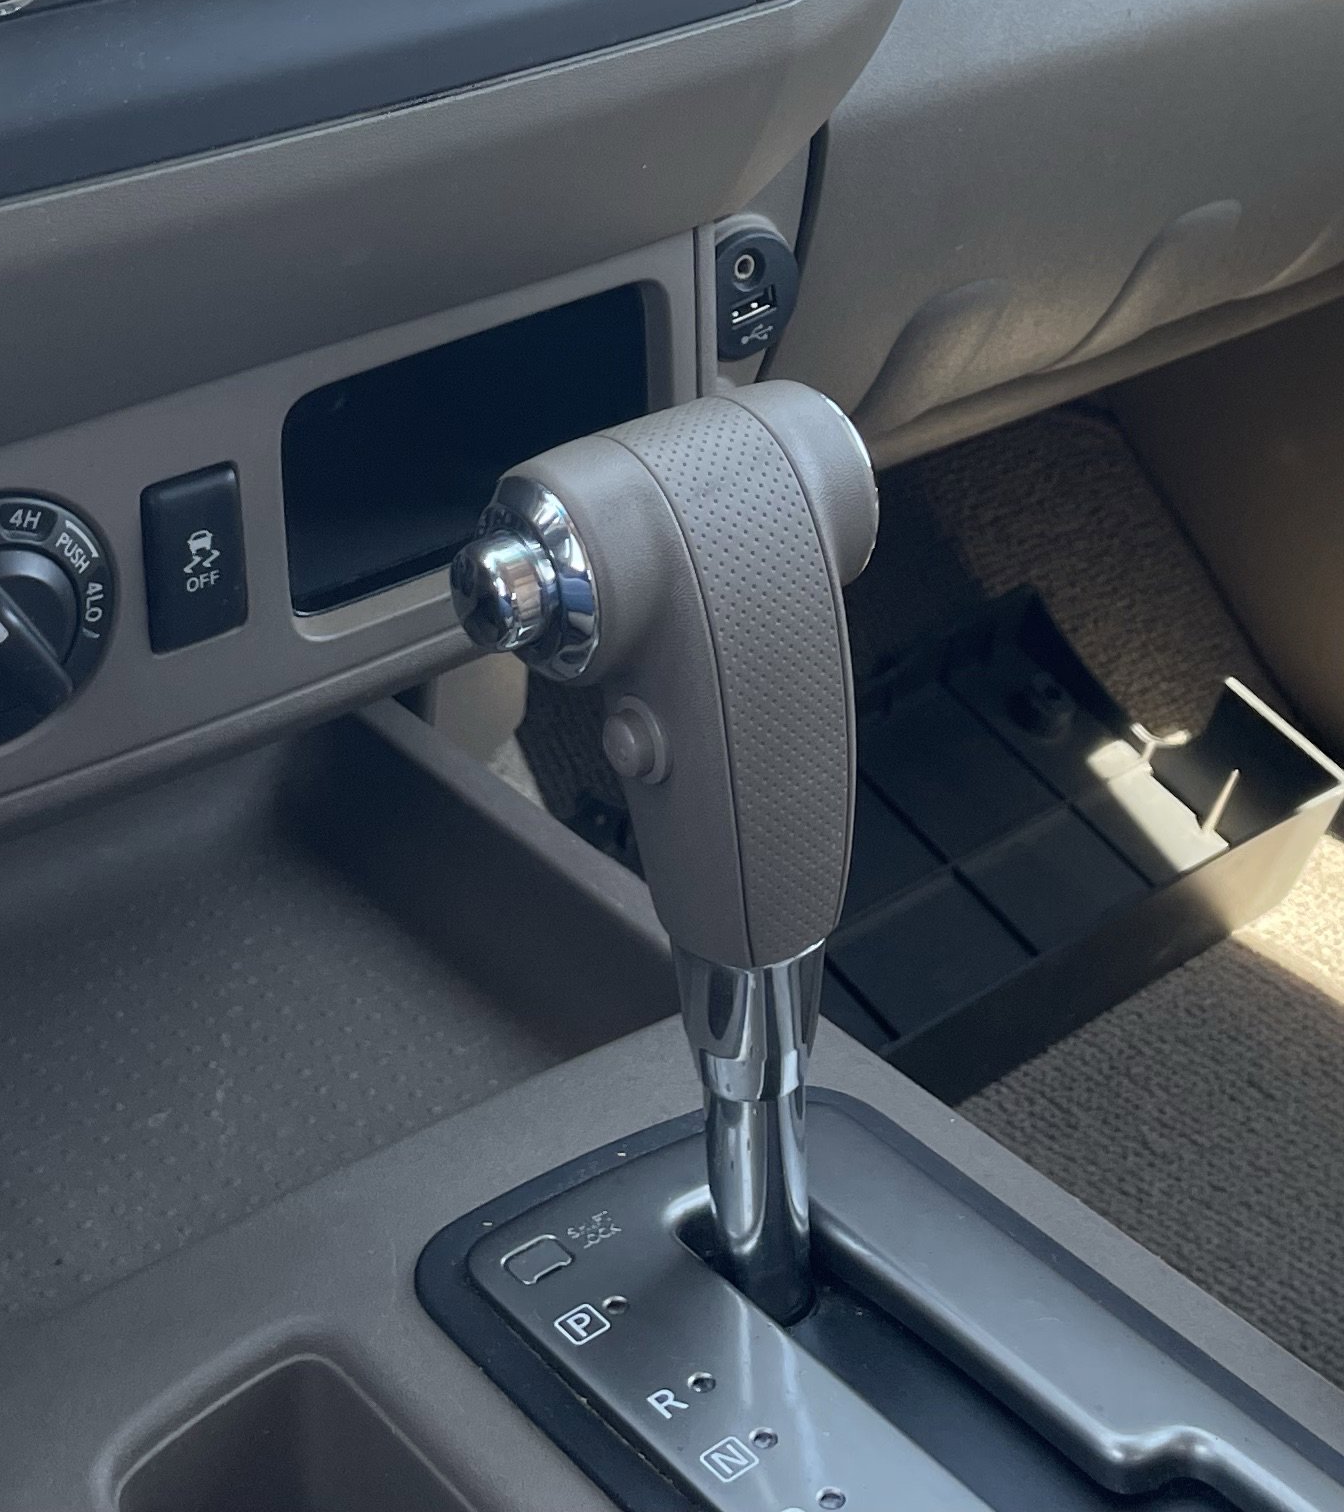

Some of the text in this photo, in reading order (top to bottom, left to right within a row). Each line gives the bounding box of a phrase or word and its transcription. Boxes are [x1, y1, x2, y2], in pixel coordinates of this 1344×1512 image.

[9, 508, 42, 529] 4H
[55, 532, 90, 574] PUSH
[186, 570, 221, 593] OFF
[85, 581, 103, 623] 4LO
[567, 1313, 594, 1338] P
[646, 1388, 689, 1419] R
[711, 1443, 749, 1475] N
